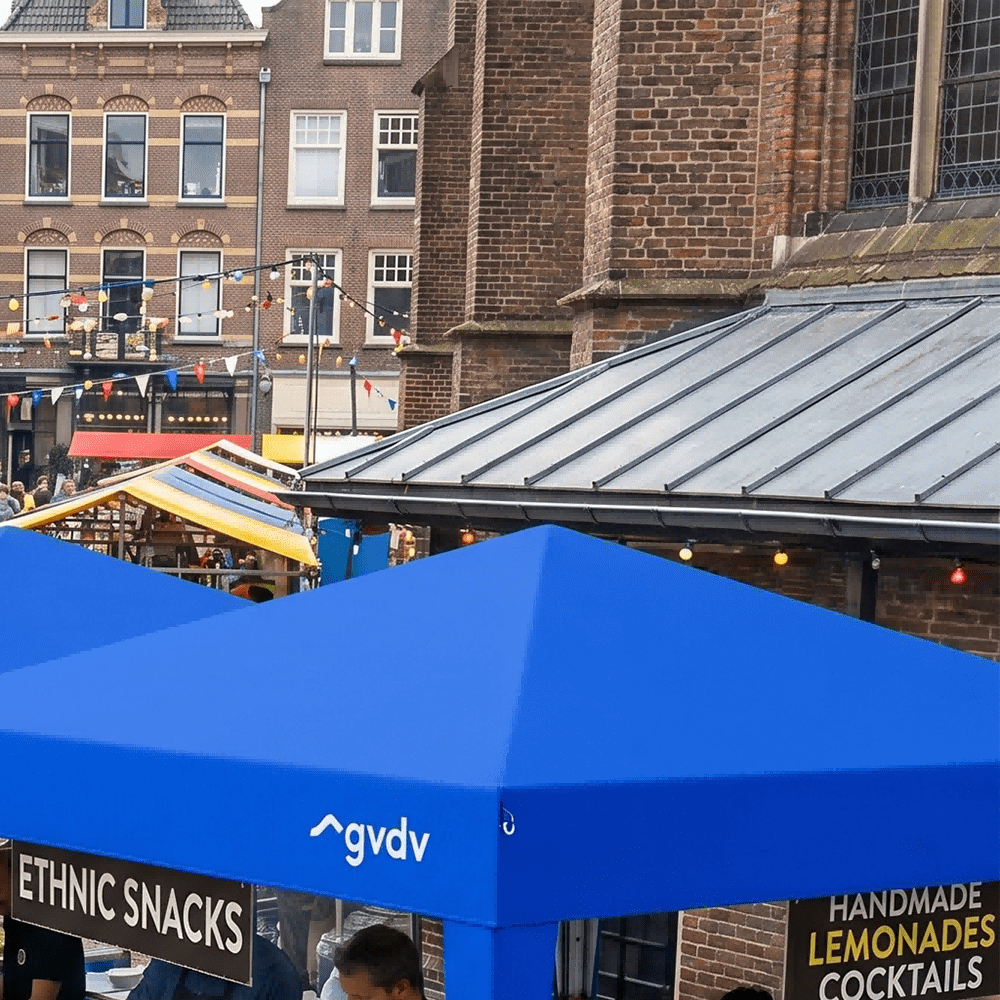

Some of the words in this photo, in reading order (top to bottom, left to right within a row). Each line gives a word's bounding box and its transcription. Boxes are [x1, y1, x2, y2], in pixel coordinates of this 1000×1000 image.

[18, 853, 116, 921] ETHNIC
[122, 878, 244, 954] SNACKS
[829, 882, 982, 922] HANDMADE
[808, 913, 996, 967] LEMONADES
